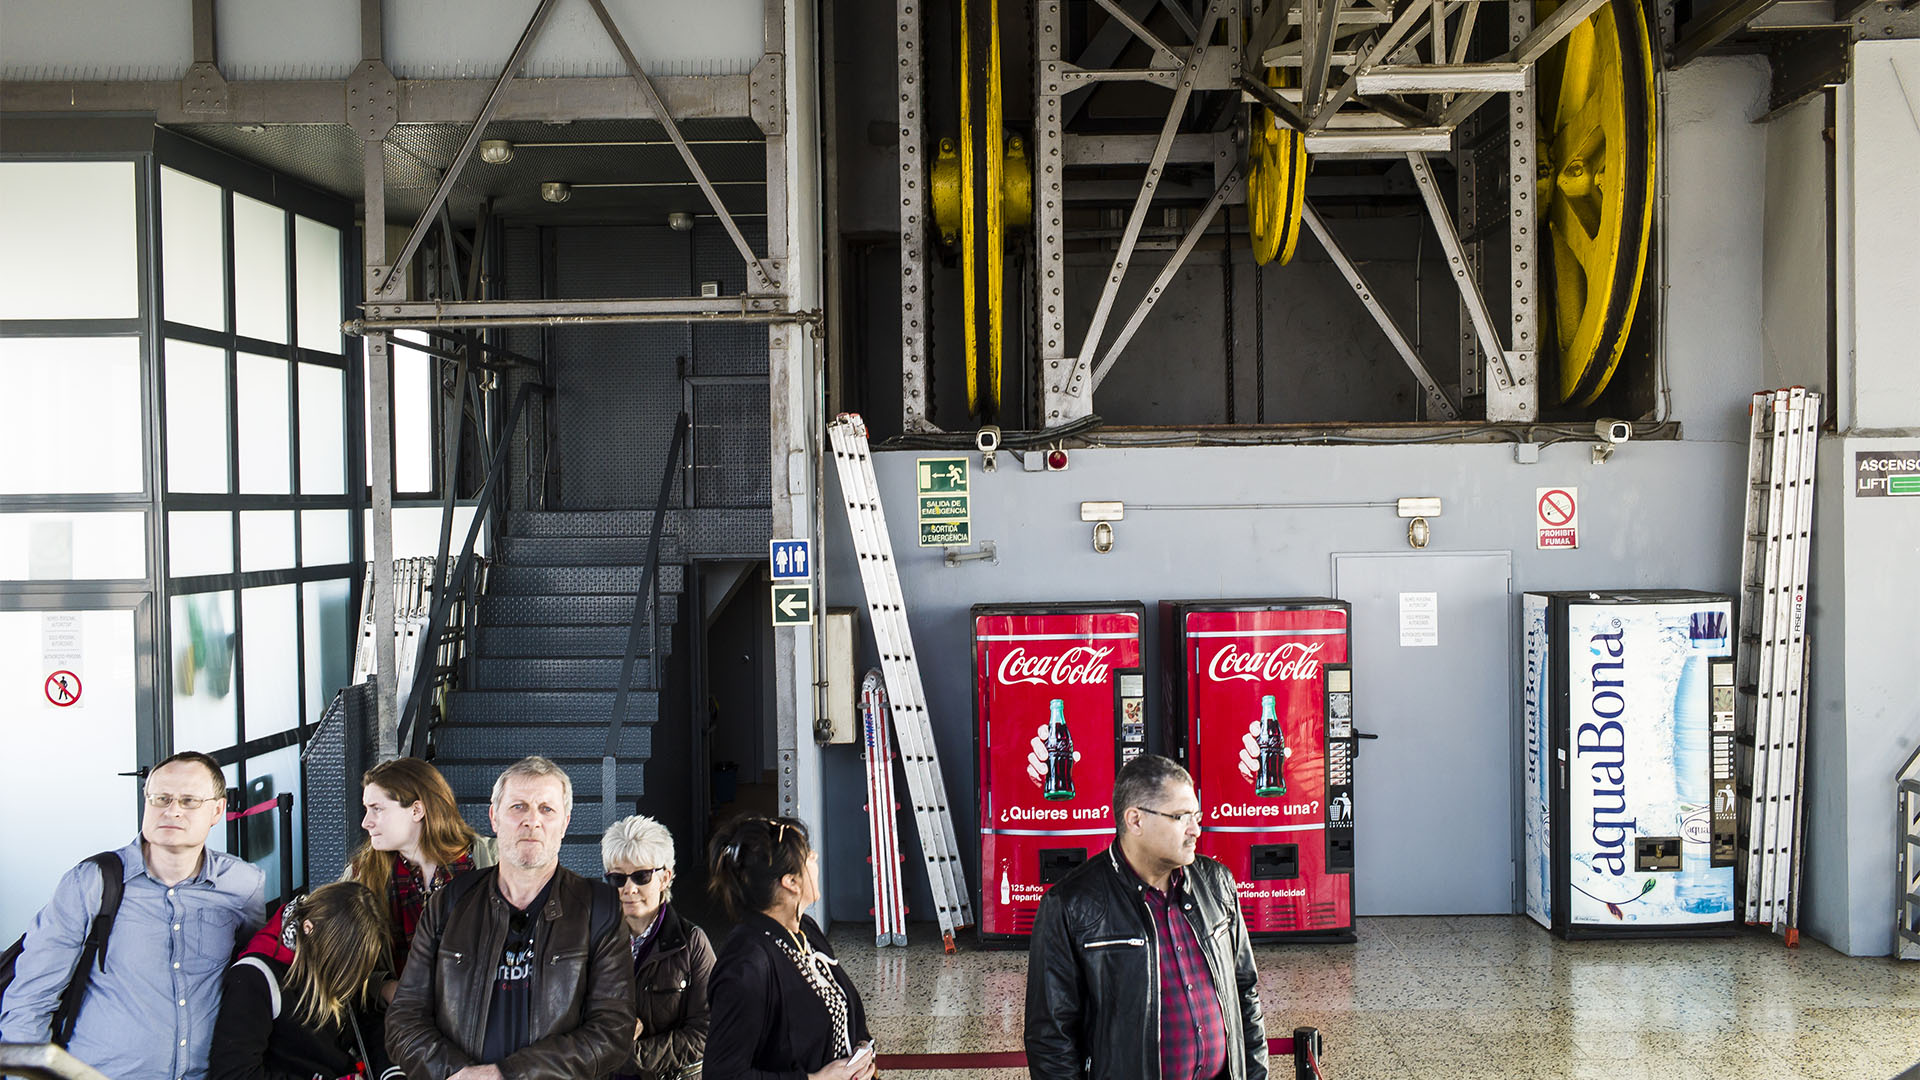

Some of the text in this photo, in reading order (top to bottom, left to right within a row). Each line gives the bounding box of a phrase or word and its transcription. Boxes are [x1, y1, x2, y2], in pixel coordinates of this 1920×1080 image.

[1860, 478, 1888, 489] LIFT
[1540, 529, 1575, 537] PROHIBIT
[998, 646, 1115, 686] Coca-Cola
[1208, 642, 1325, 682] Coca-Cola
[1000, 805, 1110, 822] ¿Quieres una?
[1210, 801, 1319, 820] ¿Quieres una?
[1011, 884, 1025, 892] 125
[1025, 884, 1044, 892] años
[1271, 888, 1306, 897] felicidad
